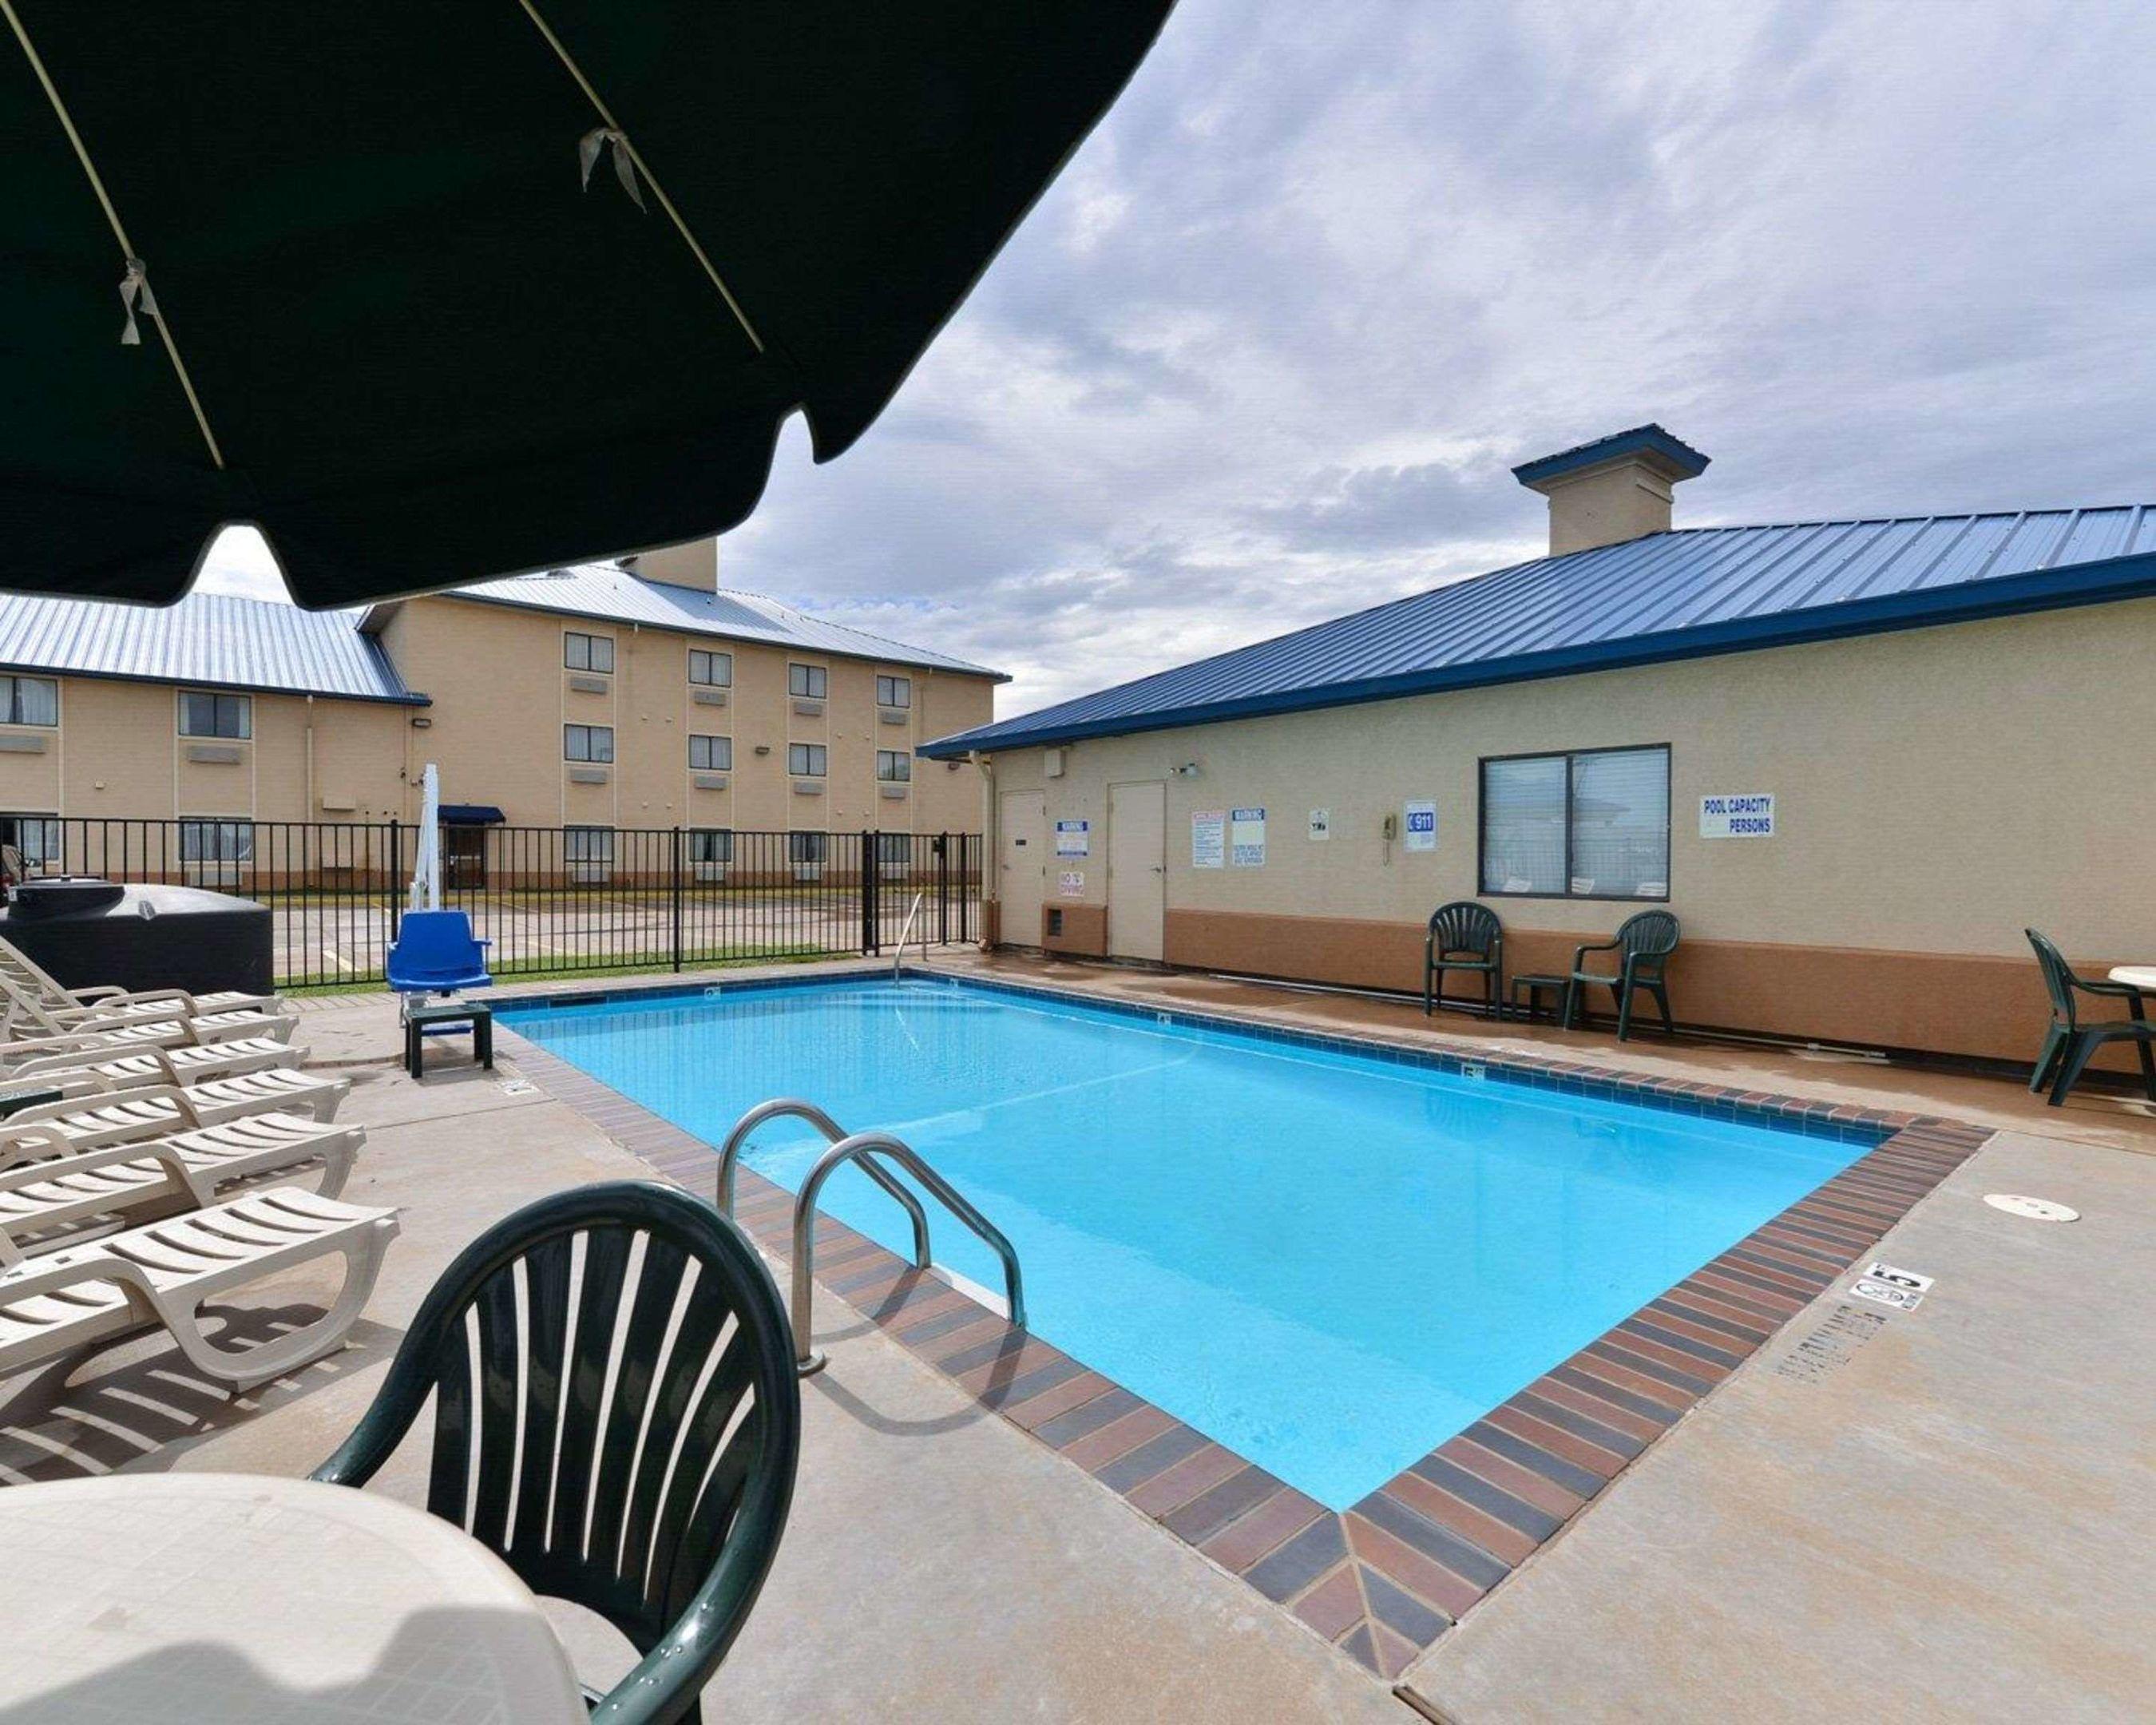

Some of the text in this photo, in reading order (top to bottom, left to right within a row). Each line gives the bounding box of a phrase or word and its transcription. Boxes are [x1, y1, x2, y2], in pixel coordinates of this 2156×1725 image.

[1704, 798, 1771, 814] POOL CAPACITY
[1415, 814, 1432, 829] 911
[1730, 819, 1770, 833] PERSONS
